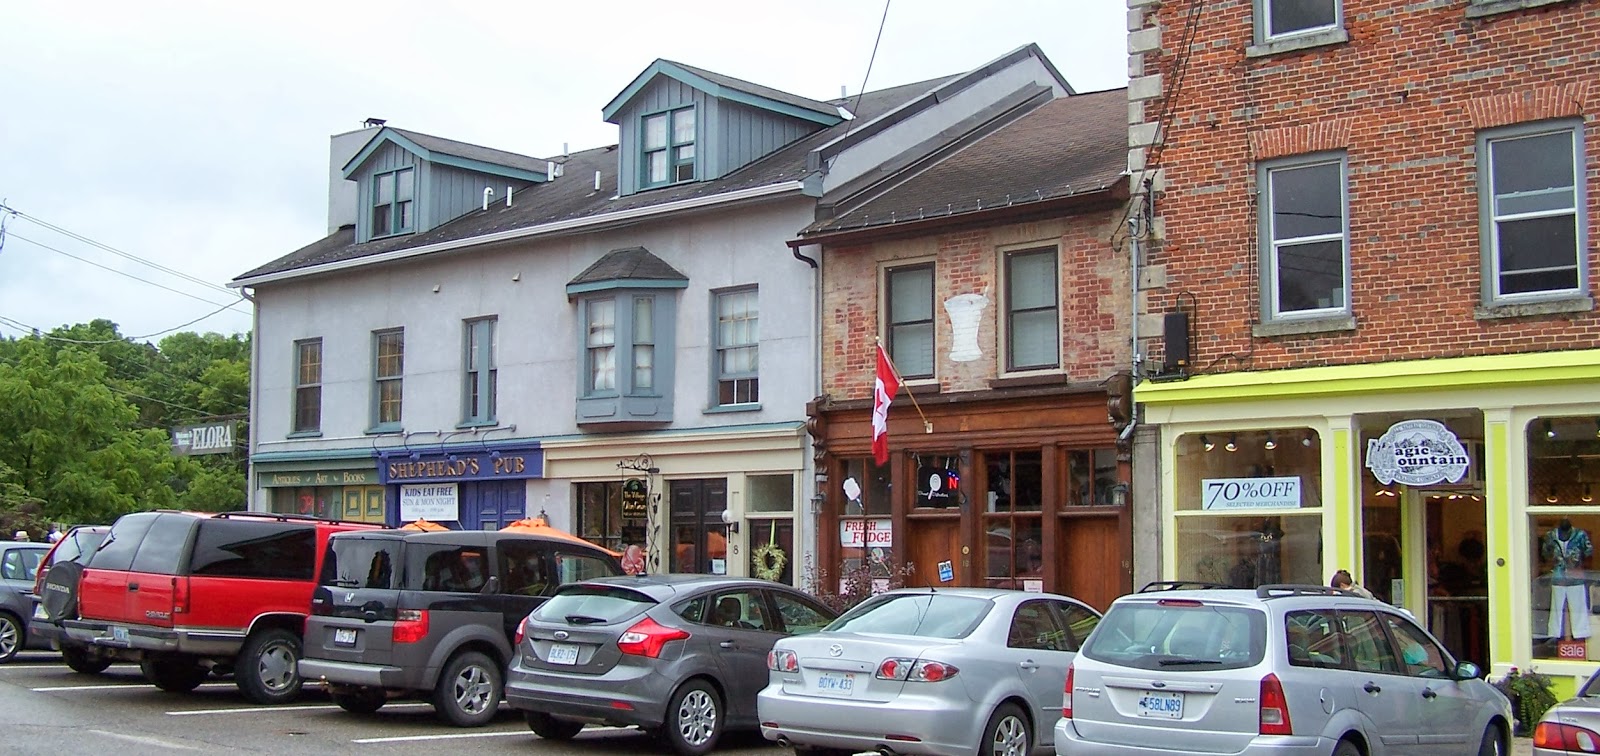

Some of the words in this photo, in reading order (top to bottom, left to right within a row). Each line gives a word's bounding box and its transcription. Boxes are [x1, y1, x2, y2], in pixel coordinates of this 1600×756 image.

[192, 424, 233, 450] ELORA
[389, 457, 480, 479] SHEPHERD'S
[494, 456, 525, 474] PUB
[404, 488, 421, 497] KIDS
[423, 487, 435, 496] EAT
[437, 486, 453, 496] FREE
[421, 498, 434, 506] MON
[845, 522, 876, 532] FRESH
[852, 531, 891, 544] FUDGE
[734, 544, 739, 554] 8
[46, 582, 70, 594] HONDA
[1560, 645, 1584, 657] sale
[1149, 699, 1180, 712] 58LN89
